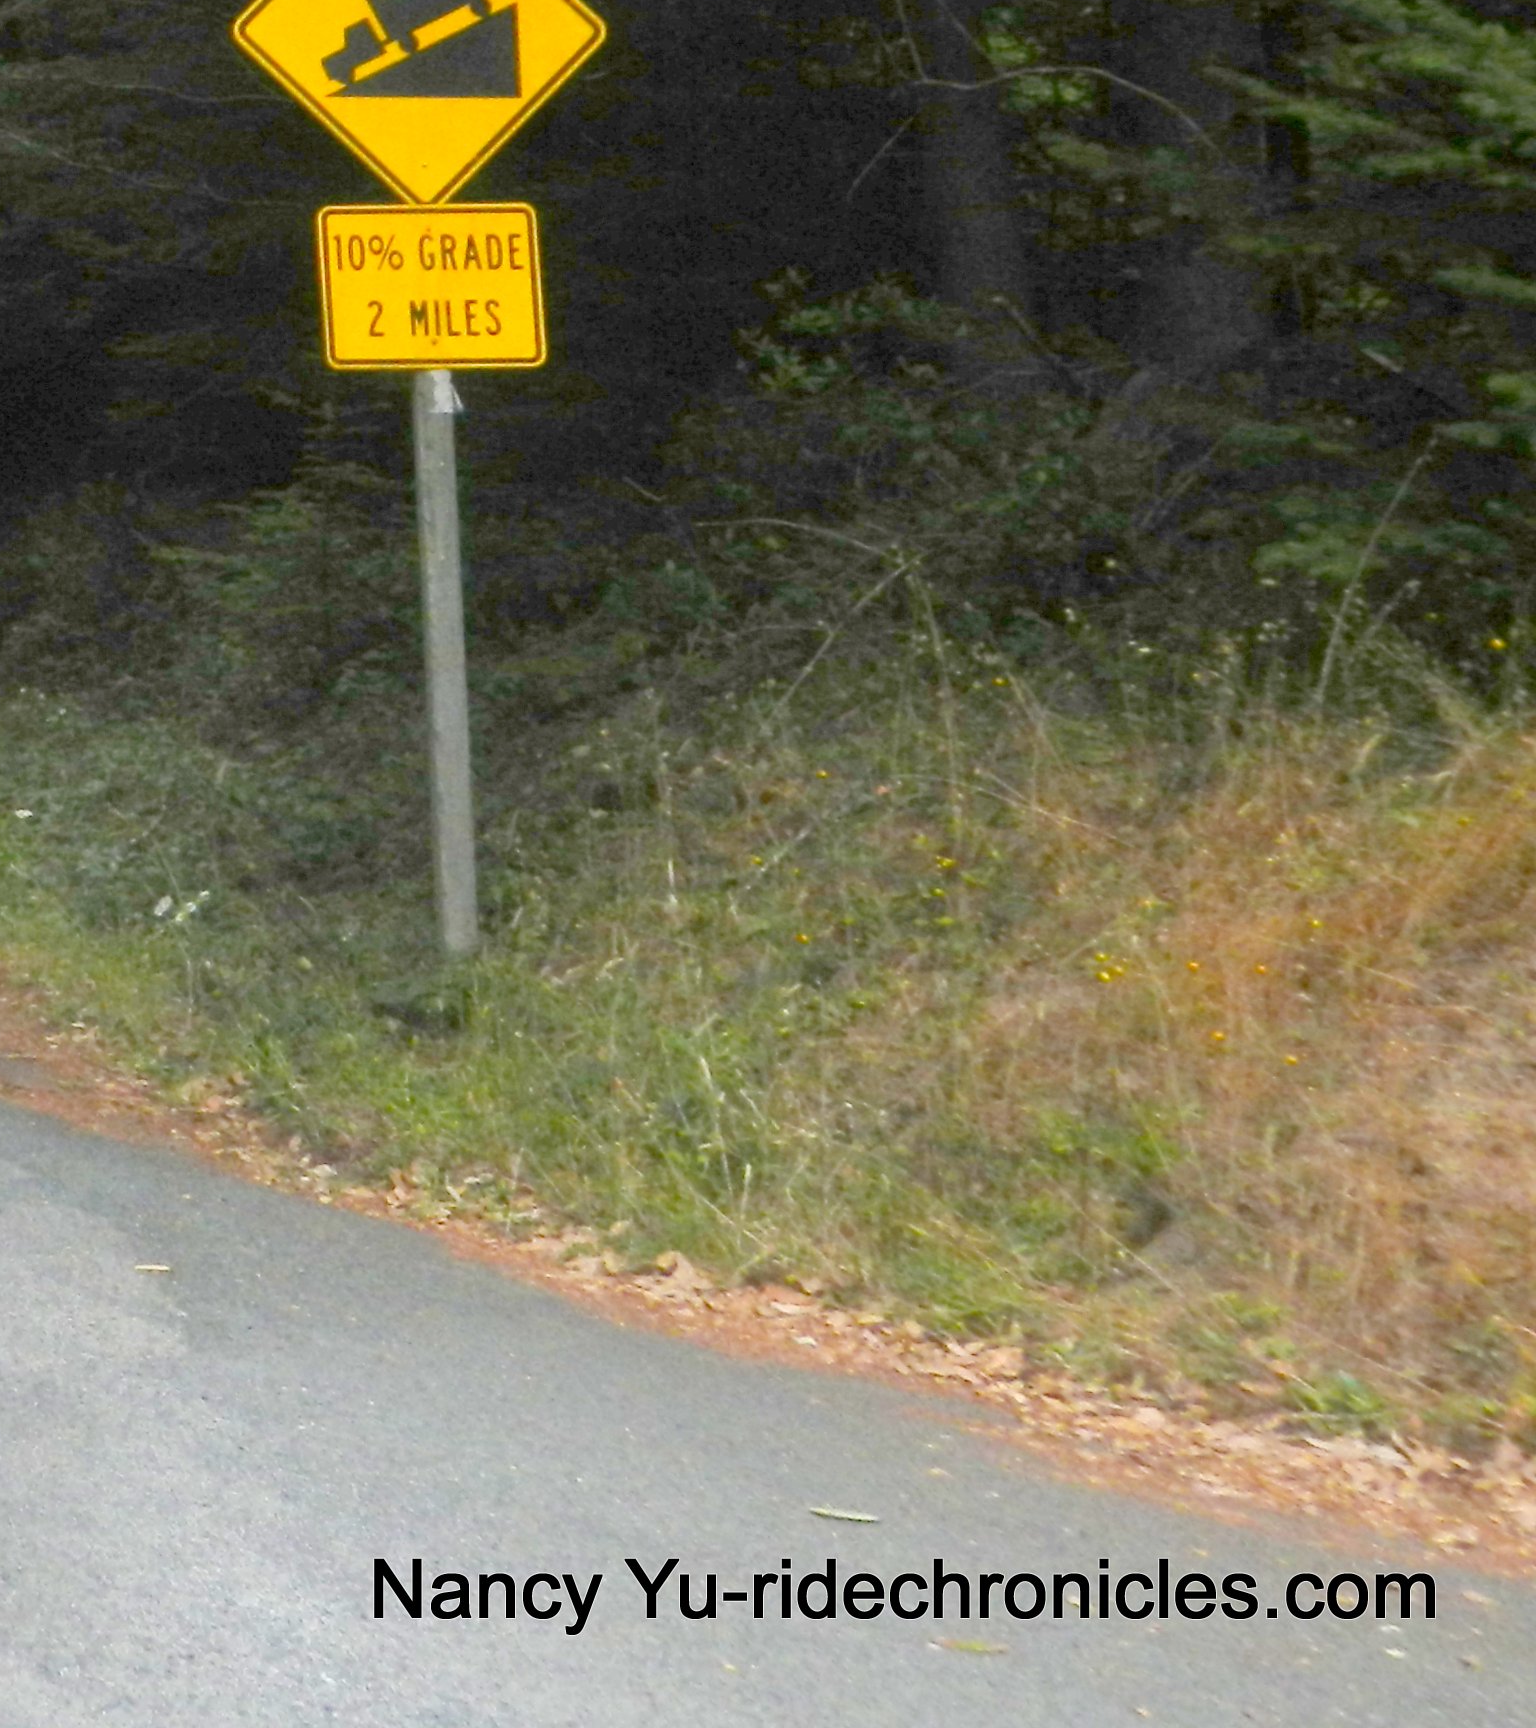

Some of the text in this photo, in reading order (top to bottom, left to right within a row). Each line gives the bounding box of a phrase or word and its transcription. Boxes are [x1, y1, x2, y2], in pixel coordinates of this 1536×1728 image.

[333, 233, 524, 271] 10% GRADE
[367, 299, 502, 337] 2 MILES
